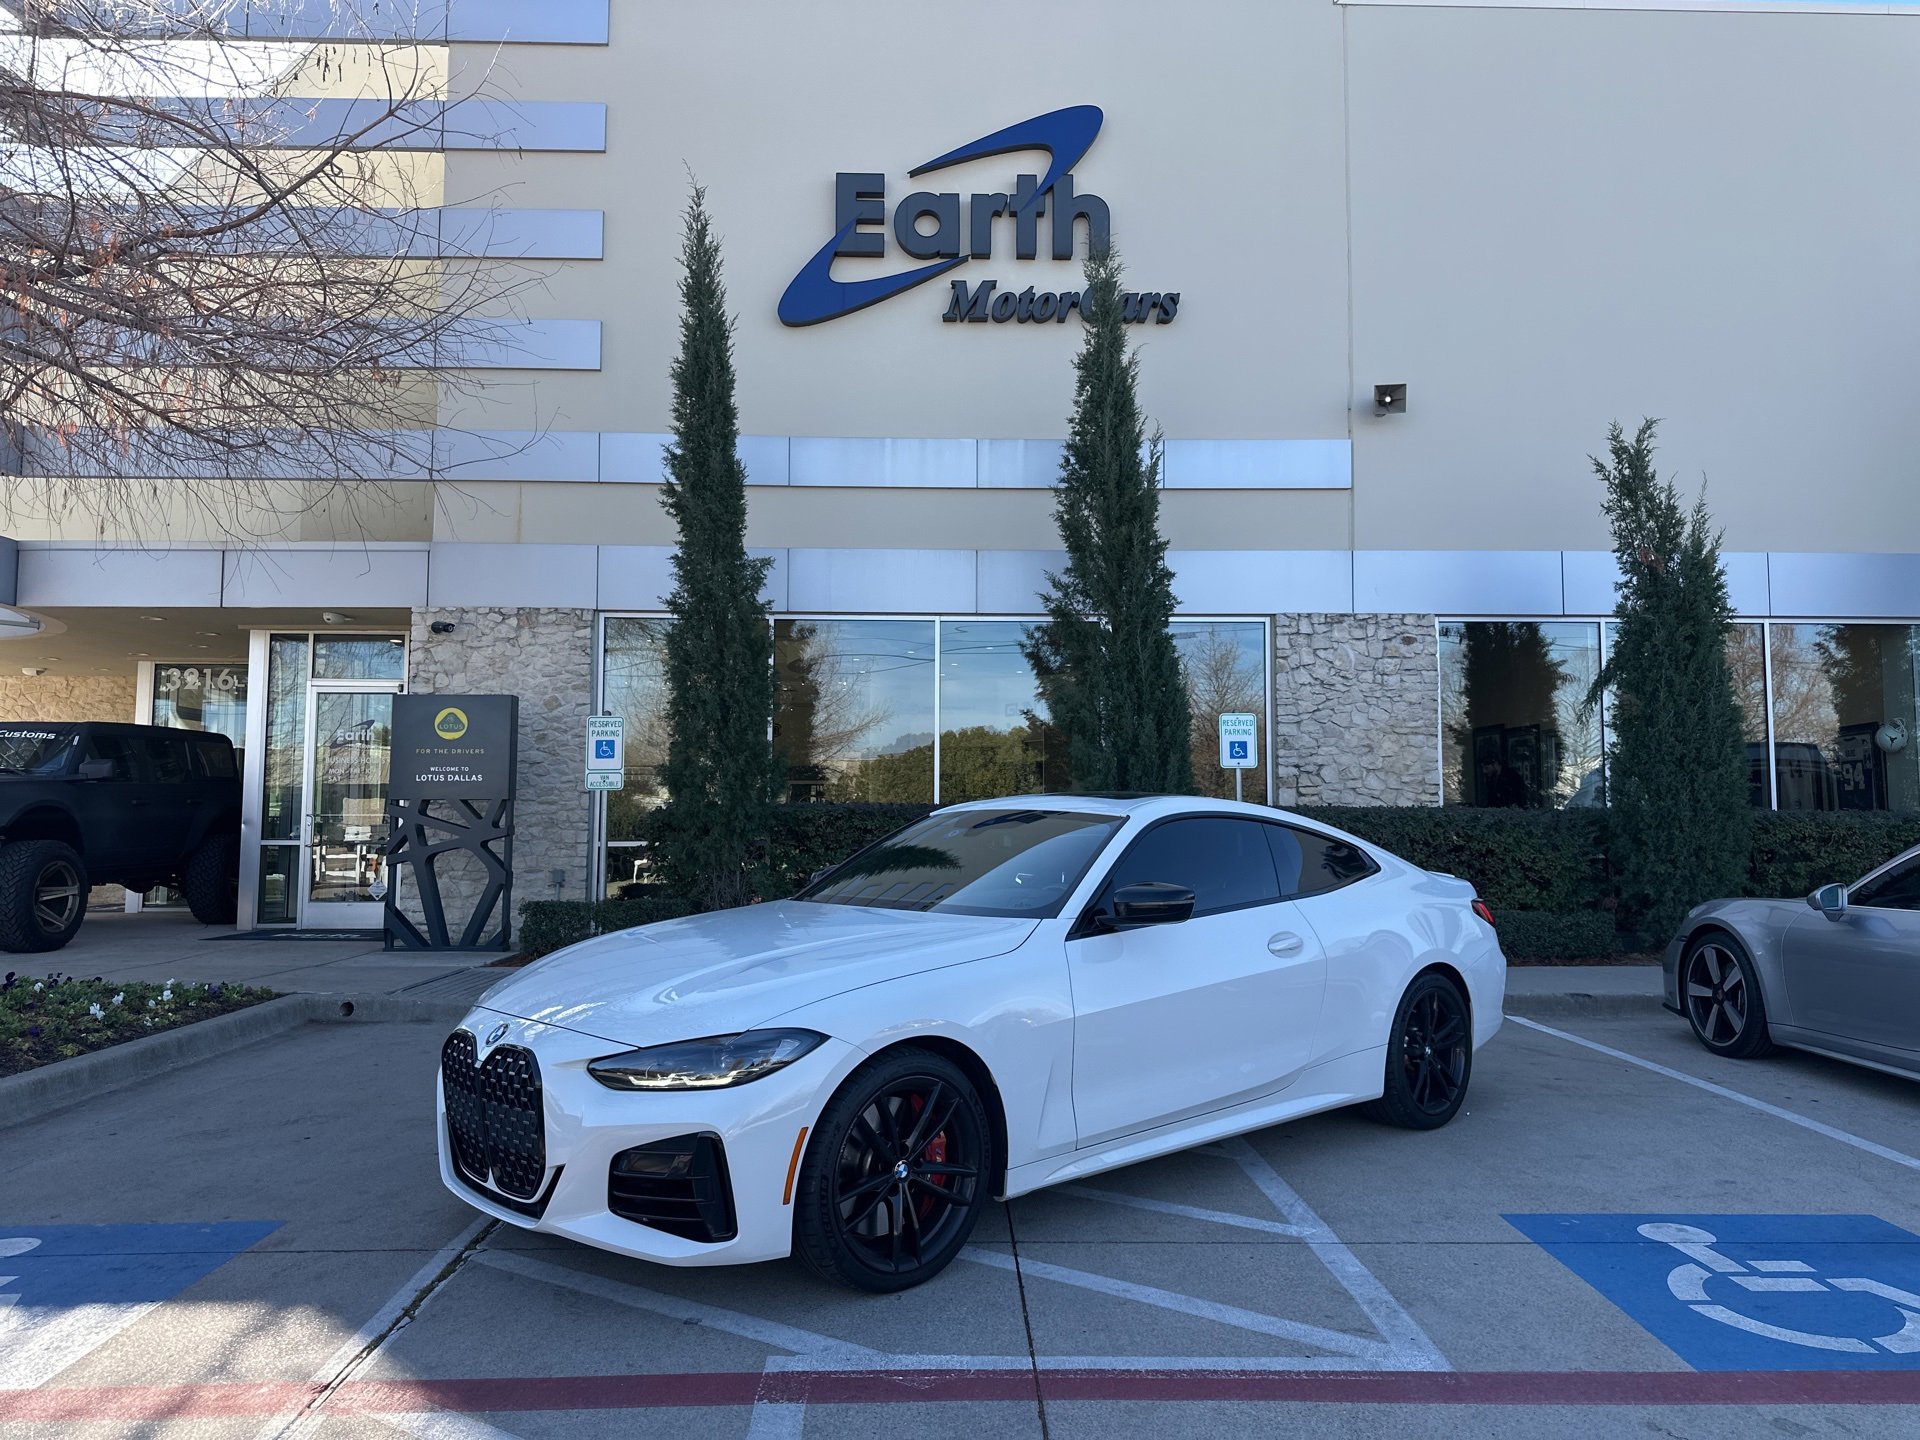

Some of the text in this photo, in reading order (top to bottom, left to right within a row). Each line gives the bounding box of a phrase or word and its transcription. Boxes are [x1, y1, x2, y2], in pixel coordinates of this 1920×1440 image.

[836, 172, 1111, 260] Earth
[167, 667, 234, 691] 3216
[589, 720, 622, 728] RESERVED
[1222, 719, 1254, 727] RESERVED
[591, 729, 620, 737] PARKING
[1224, 728, 1252, 736] PARKING
[336, 729, 375, 744] Earth
[415, 774, 483, 782] LOTUS DALLAS
